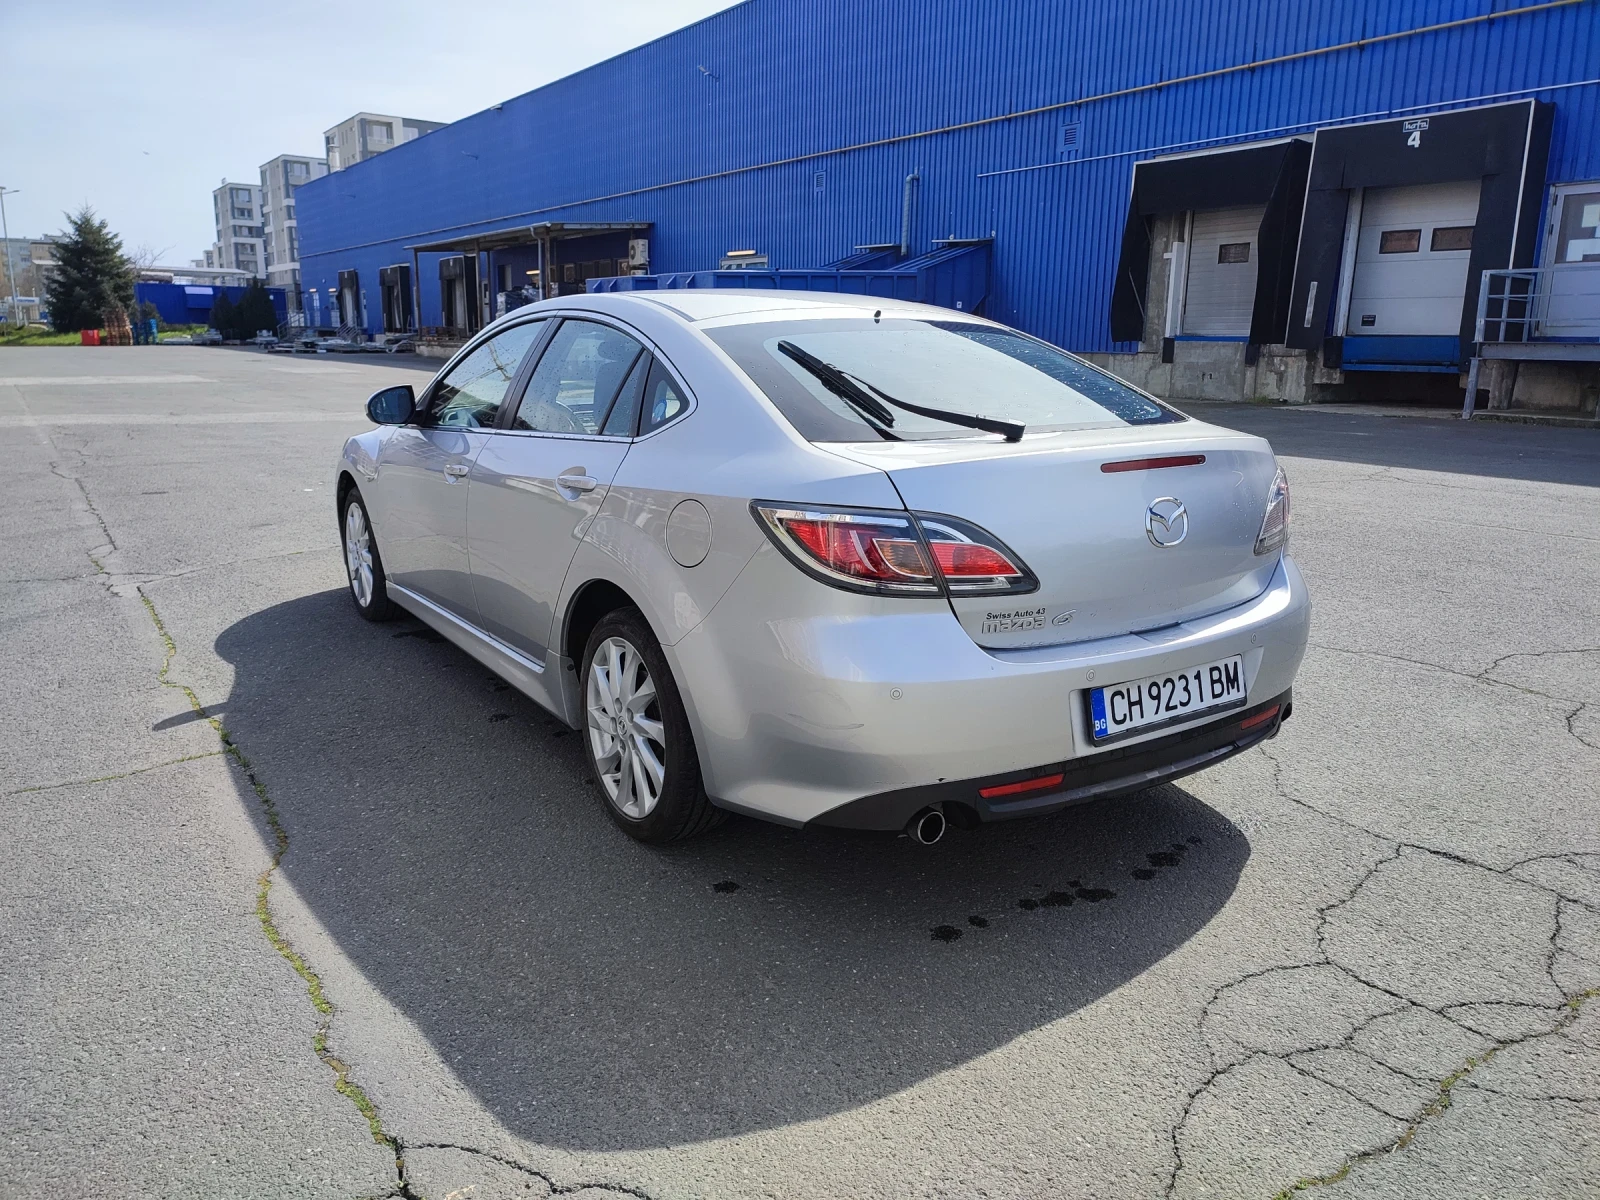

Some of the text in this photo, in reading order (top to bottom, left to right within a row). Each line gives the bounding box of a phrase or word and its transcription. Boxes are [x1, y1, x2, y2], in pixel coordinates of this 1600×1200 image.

[1407, 131, 1420, 148] 4
[986, 607, 1046, 620] Swiss Auto 43
[1110, 661, 1241, 725] CH 9231 BM
[1094, 718, 1107, 731] BG
